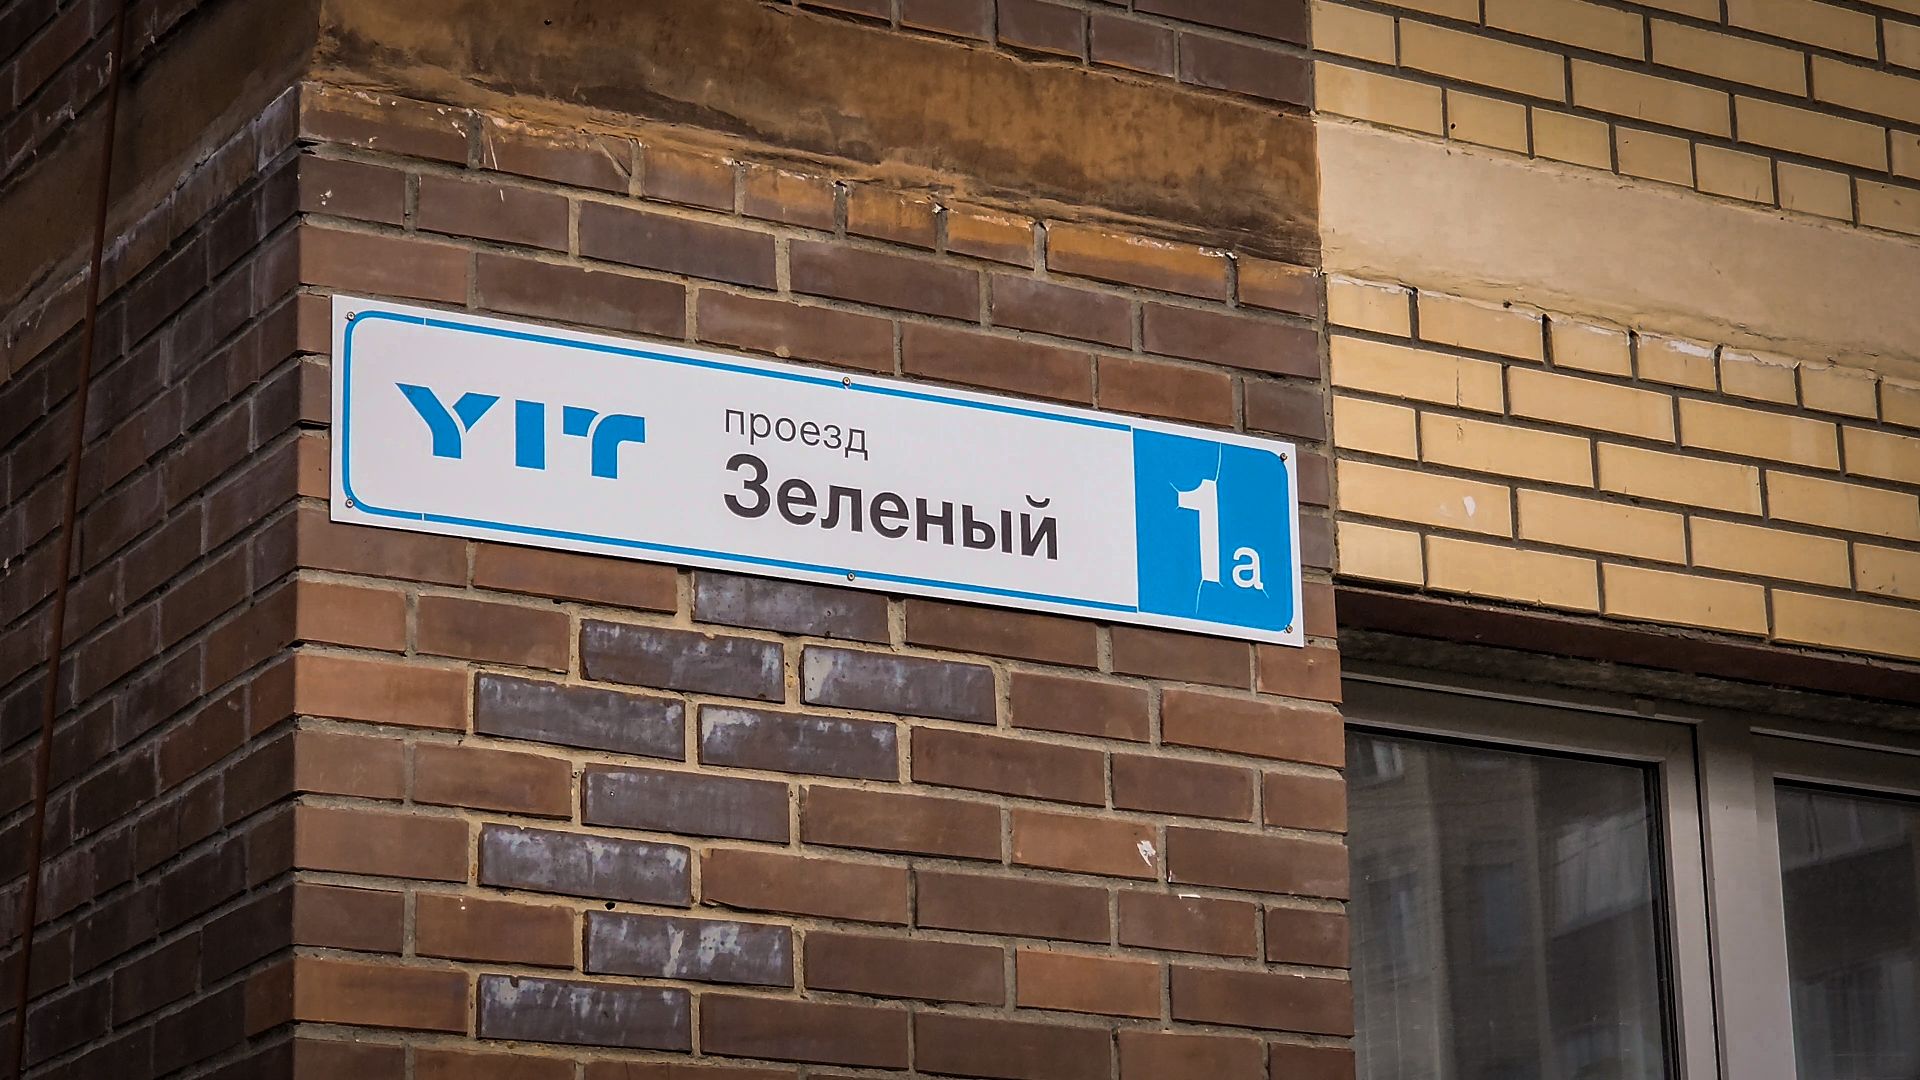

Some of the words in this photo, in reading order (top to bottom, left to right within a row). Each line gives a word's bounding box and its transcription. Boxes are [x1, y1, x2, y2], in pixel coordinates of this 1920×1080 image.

[394, 382, 646, 480] YIT
[725, 408, 869, 462] проезд
[723, 453, 1058, 561] Зеленый
